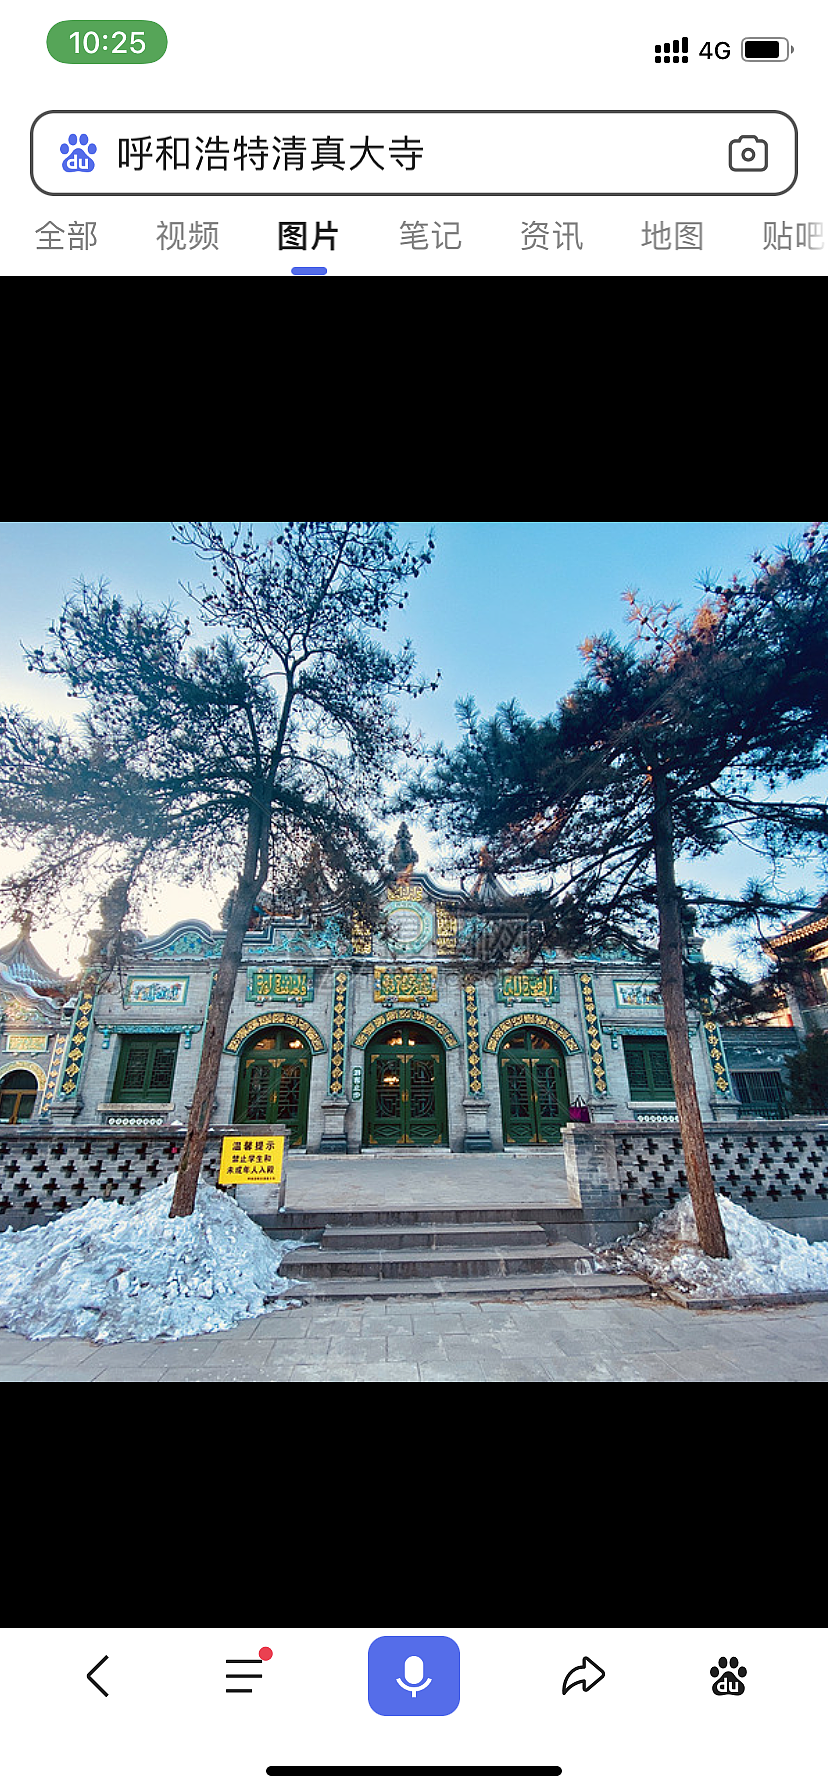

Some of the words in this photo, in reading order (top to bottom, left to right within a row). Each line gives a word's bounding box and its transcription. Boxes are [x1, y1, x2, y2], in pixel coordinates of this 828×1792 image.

[69, 30, 146, 54] 10:25
[699, 41, 731, 60] 4G
[66, 154, 89, 170] du
[118, 135, 424, 172] 呼和浩特清真大寺
[35, 220, 97, 251] 全部
[156, 220, 219, 251] 视频
[278, 220, 339, 252] 图片
[399, 220, 462, 251] 笔记
[520, 220, 583, 251] 资讯
[641, 220, 703, 251] 地图
[762, 220, 825, 251] 贴吧
[232, 1141, 275, 1151] 温馨提示
[232, 1154, 272, 1163] 禁止学生和
[227, 1165, 275, 1174] 未成年人入殿
[716, 1677, 739, 1693] du
